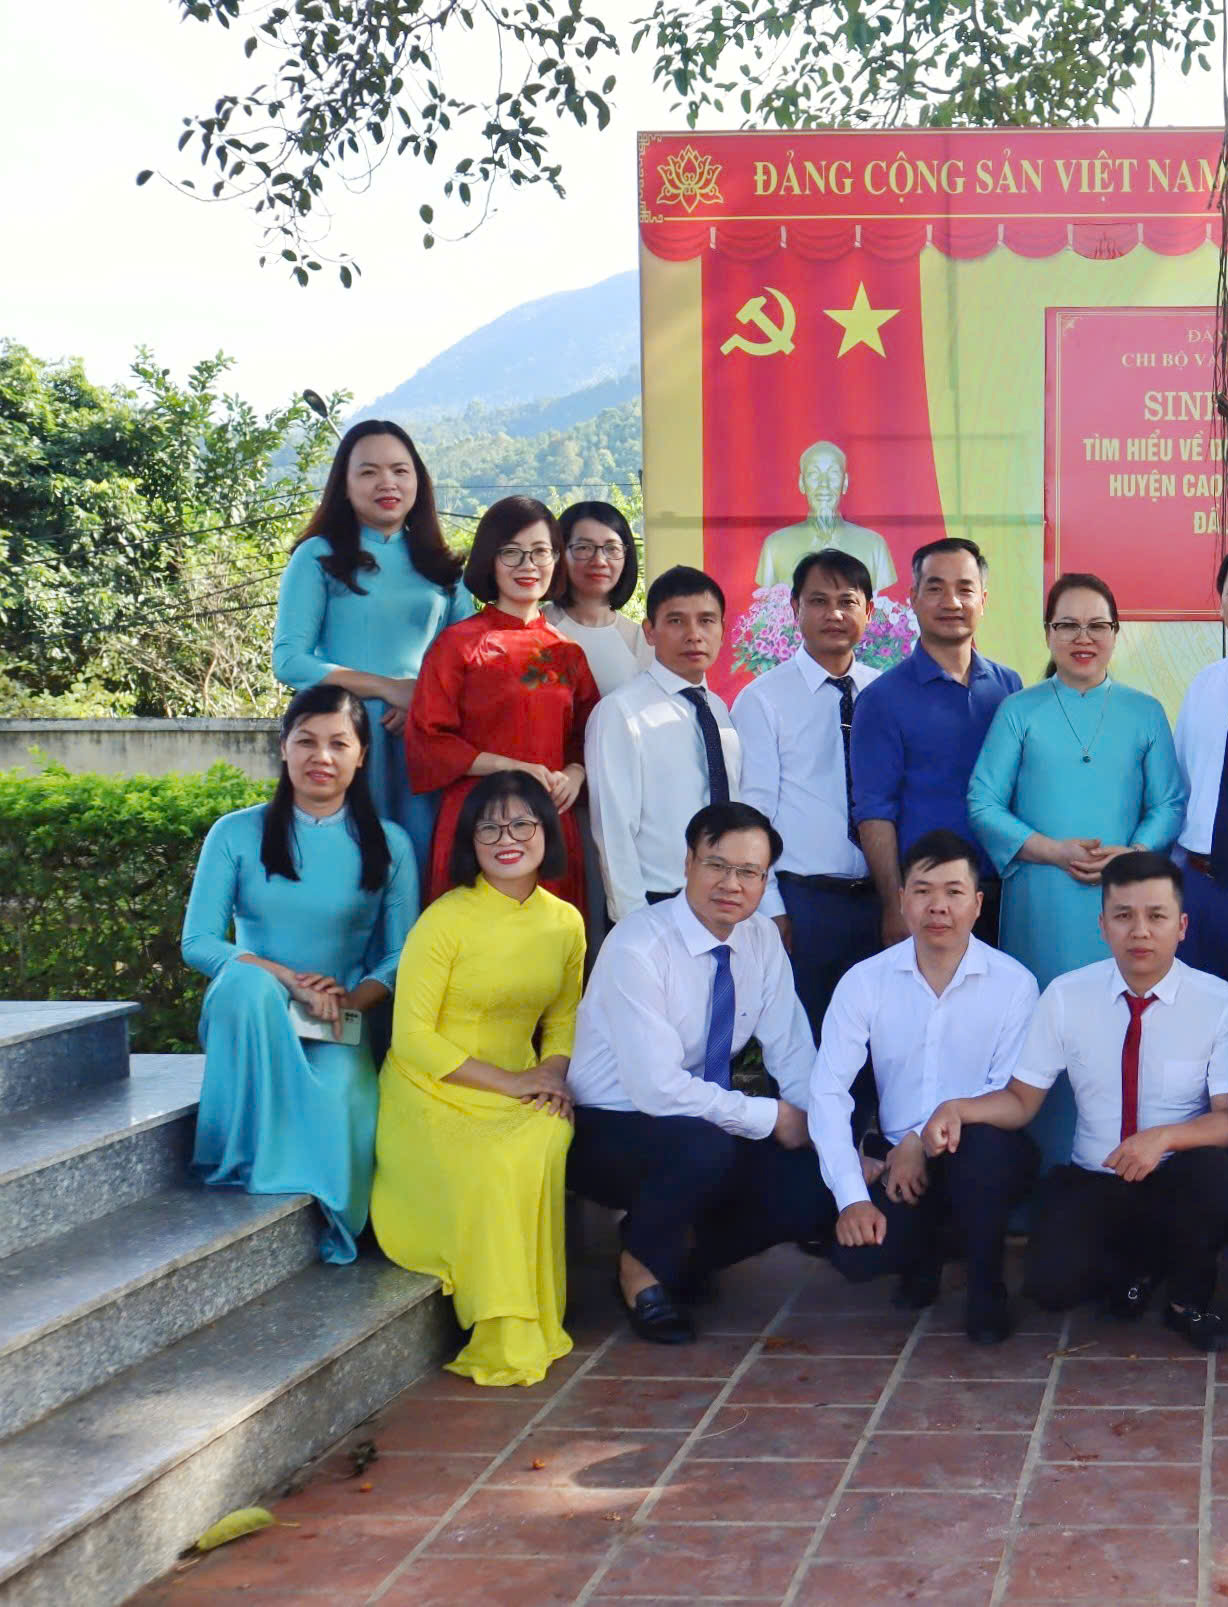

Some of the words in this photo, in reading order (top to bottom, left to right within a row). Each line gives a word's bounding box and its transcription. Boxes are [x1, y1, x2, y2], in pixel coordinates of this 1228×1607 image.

[753, 149, 855, 195] ĐẢNG
[863, 151, 966, 203] CỘNG
[975, 148, 1044, 194] SẢN
[1054, 149, 1138, 202] VIỆT
[1121, 352, 1156, 367] CHI
[1083, 433, 1120, 461] TÌM
[1126, 429, 1173, 461] HIỂU
[1179, 430, 1204, 461] VỀ
[1109, 469, 1176, 502] HUYỆN
[1182, 474, 1223, 497] CAO
